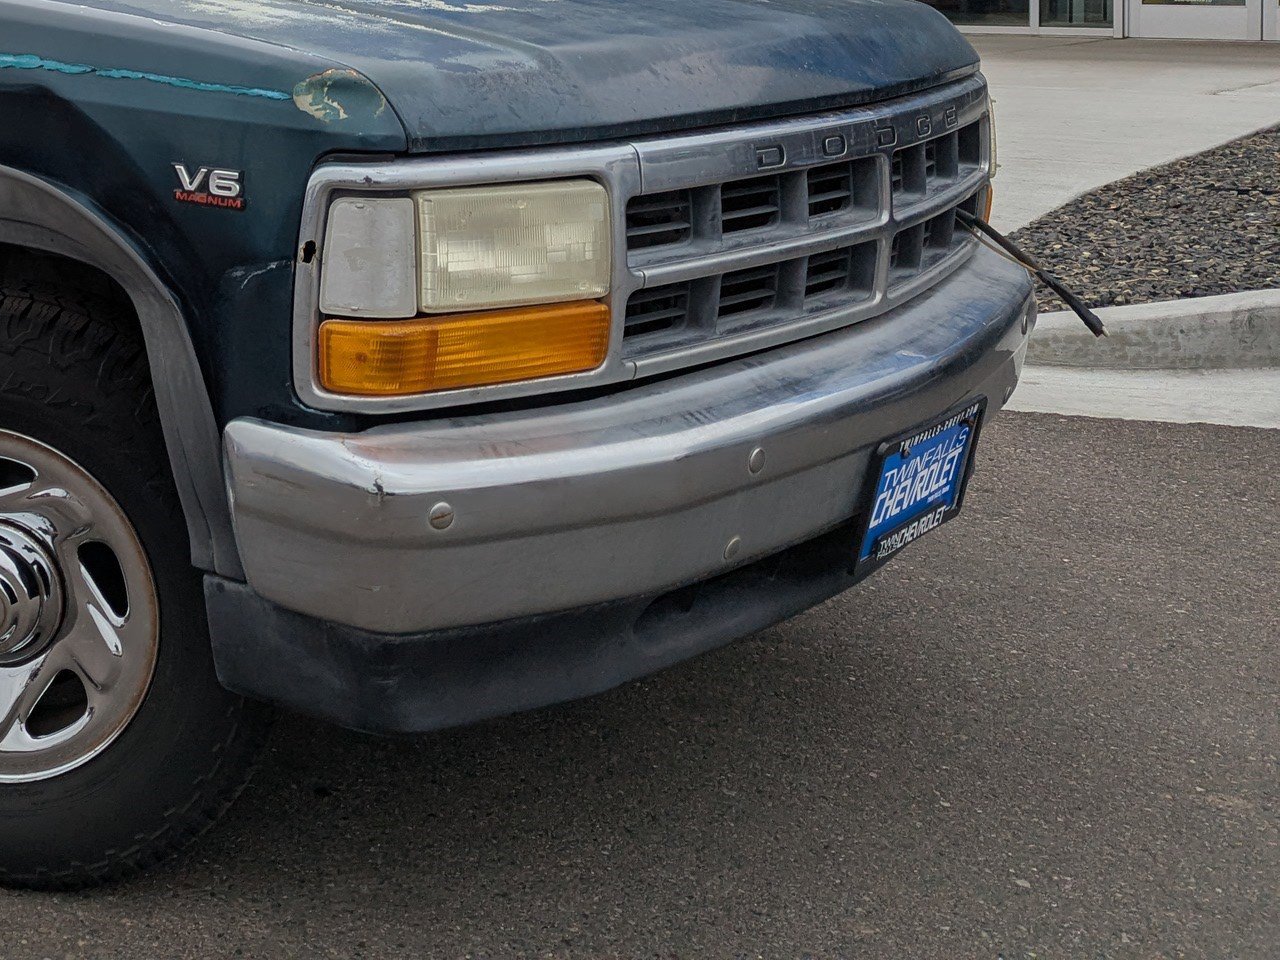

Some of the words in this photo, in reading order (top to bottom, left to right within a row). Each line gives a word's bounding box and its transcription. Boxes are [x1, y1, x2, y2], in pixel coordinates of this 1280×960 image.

[756, 105, 959, 171] DODGE
[174, 165, 240, 197] V6
[174, 191, 242, 208] MAGNUM
[884, 426, 969, 491] TWINFALLS
[869, 446, 963, 529] CHEVROLET
[895, 505, 947, 548] CHEVROLET
